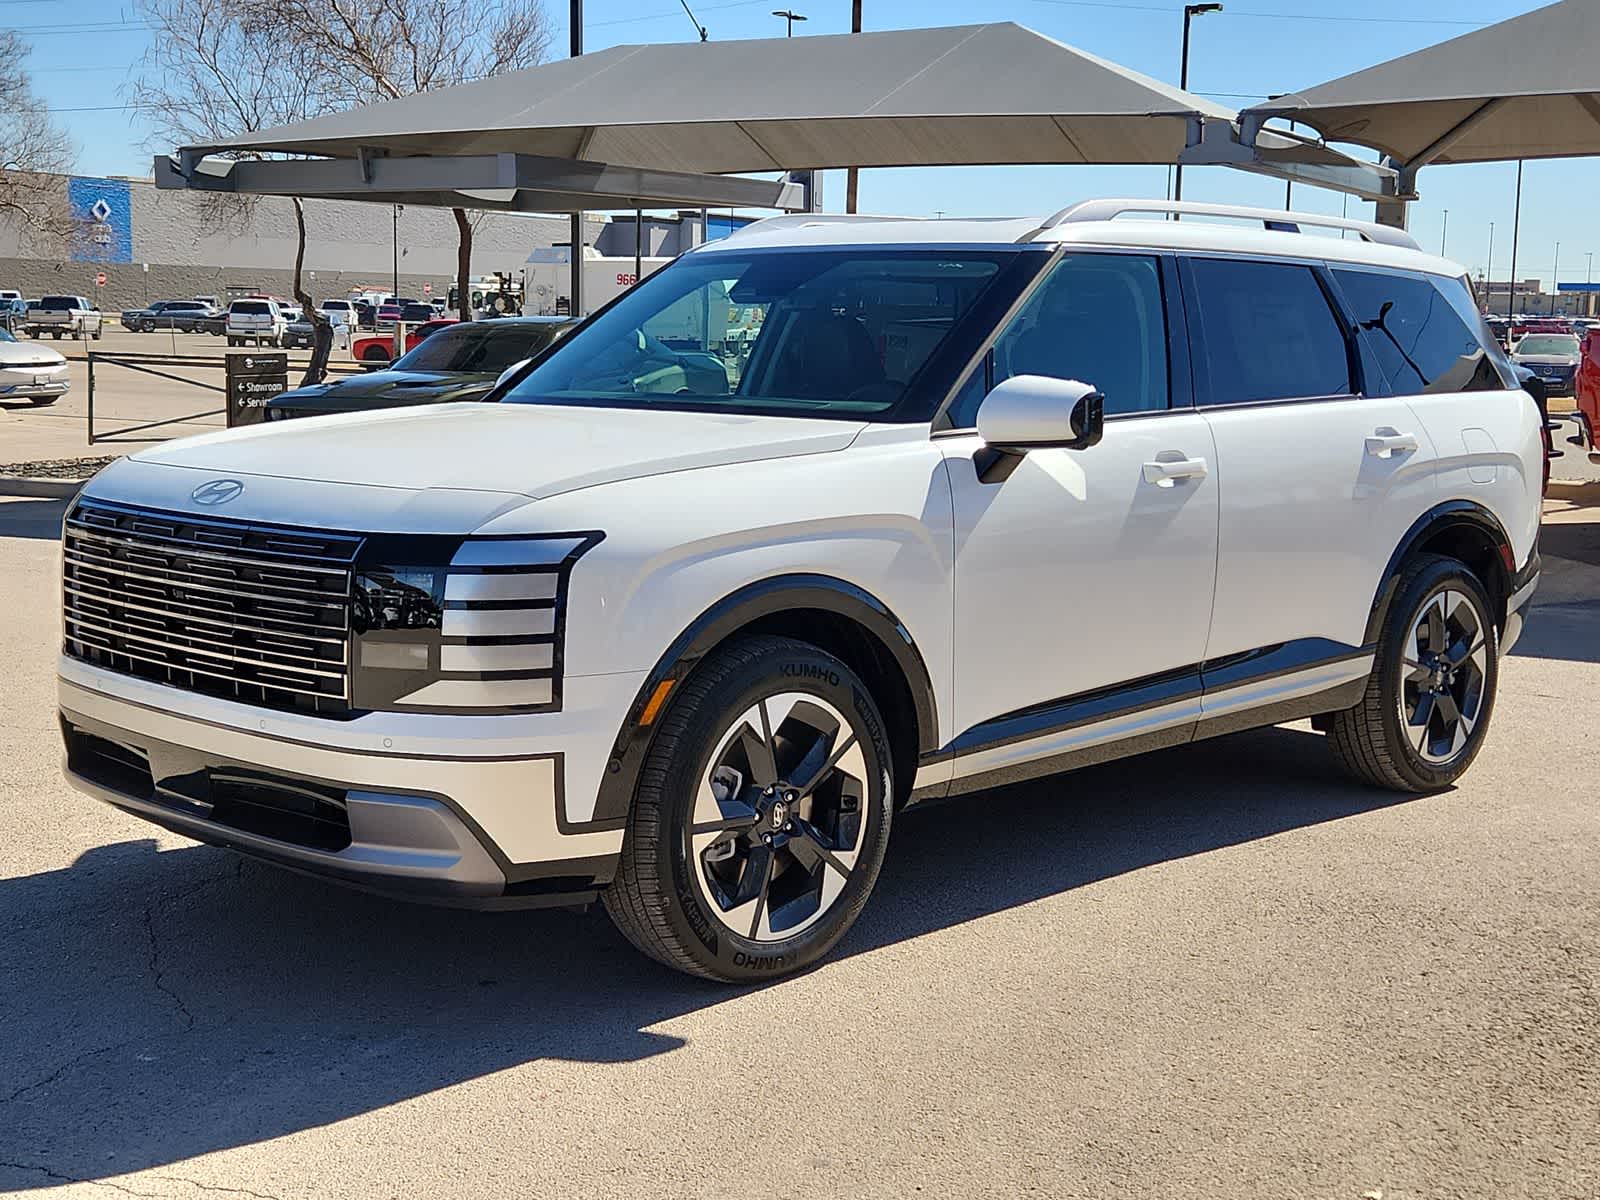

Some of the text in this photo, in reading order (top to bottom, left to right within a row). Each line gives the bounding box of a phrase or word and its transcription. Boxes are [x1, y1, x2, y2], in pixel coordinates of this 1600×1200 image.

[616, 273, 637, 286] 966
[246, 382, 283, 392] Showroom
[779, 663, 840, 687] KUMHO
[732, 952, 798, 971] KUMHO
